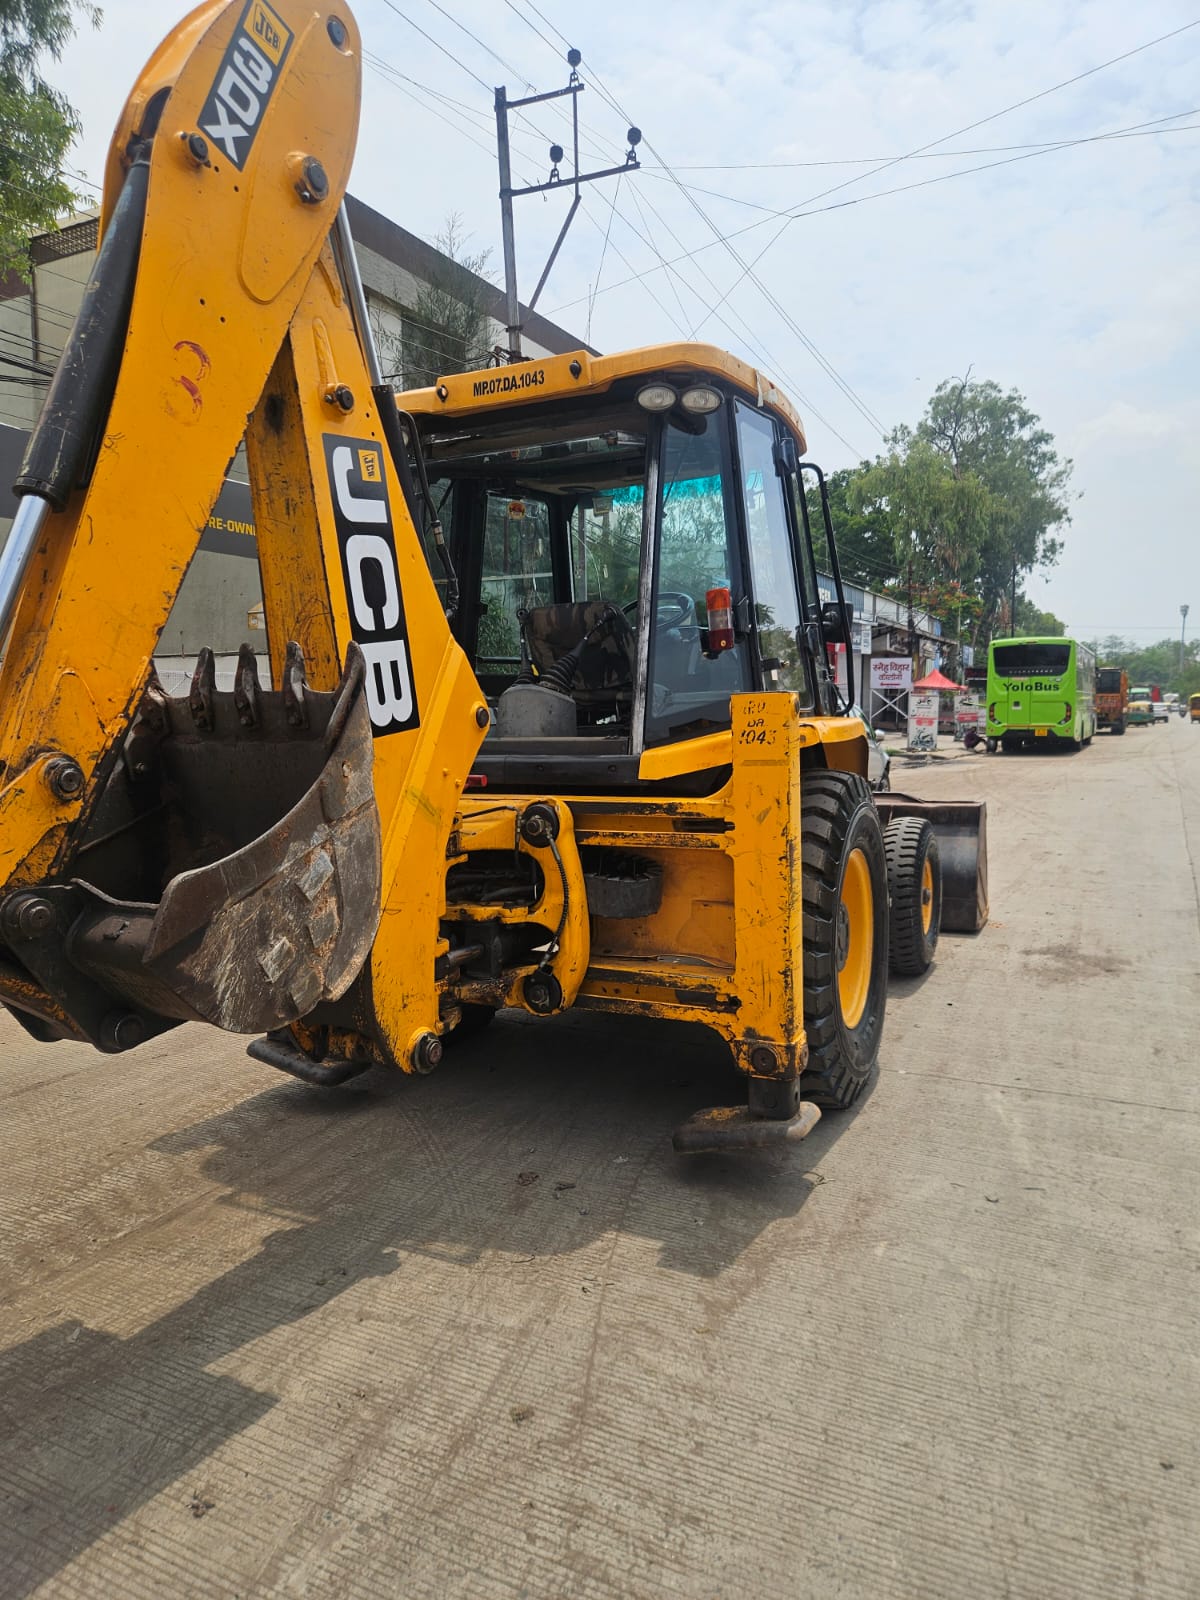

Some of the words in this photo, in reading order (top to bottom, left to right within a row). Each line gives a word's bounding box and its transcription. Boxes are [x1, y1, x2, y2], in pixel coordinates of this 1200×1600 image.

[255, 11, 280, 49] JCB
[203, 37, 273, 163] 3DX
[473, 370, 545, 397] MP.07.DA.1043
[364, 457, 375, 477] JCB
[332, 446, 413, 727] JCB
[890, 661, 910, 673] विहार
[1003, 682, 1060, 692] YoloBus
